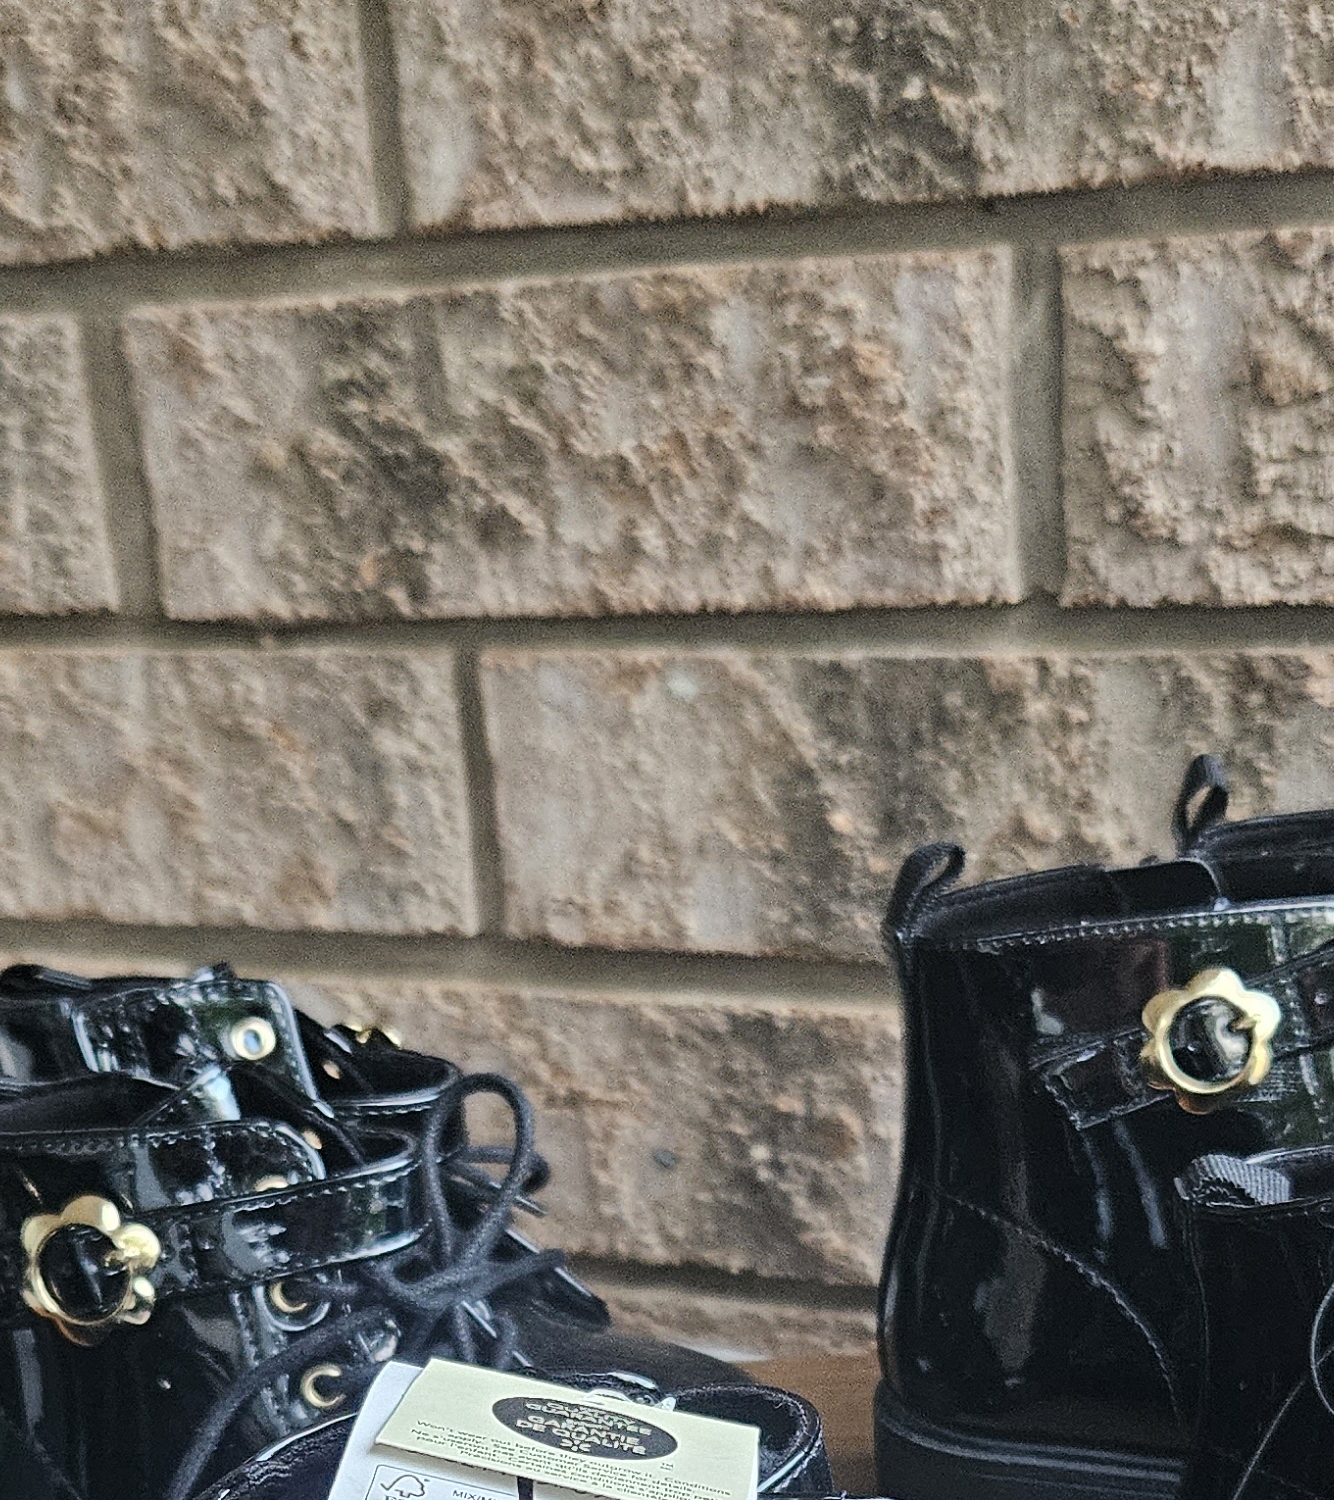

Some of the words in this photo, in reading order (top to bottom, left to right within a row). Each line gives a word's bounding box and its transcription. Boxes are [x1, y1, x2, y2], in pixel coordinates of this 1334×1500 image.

[515, 1419, 546, 1432] DE
[524, 1402, 652, 1435] GUARANTEE
[526, 1414, 639, 1445] GARANTIE
